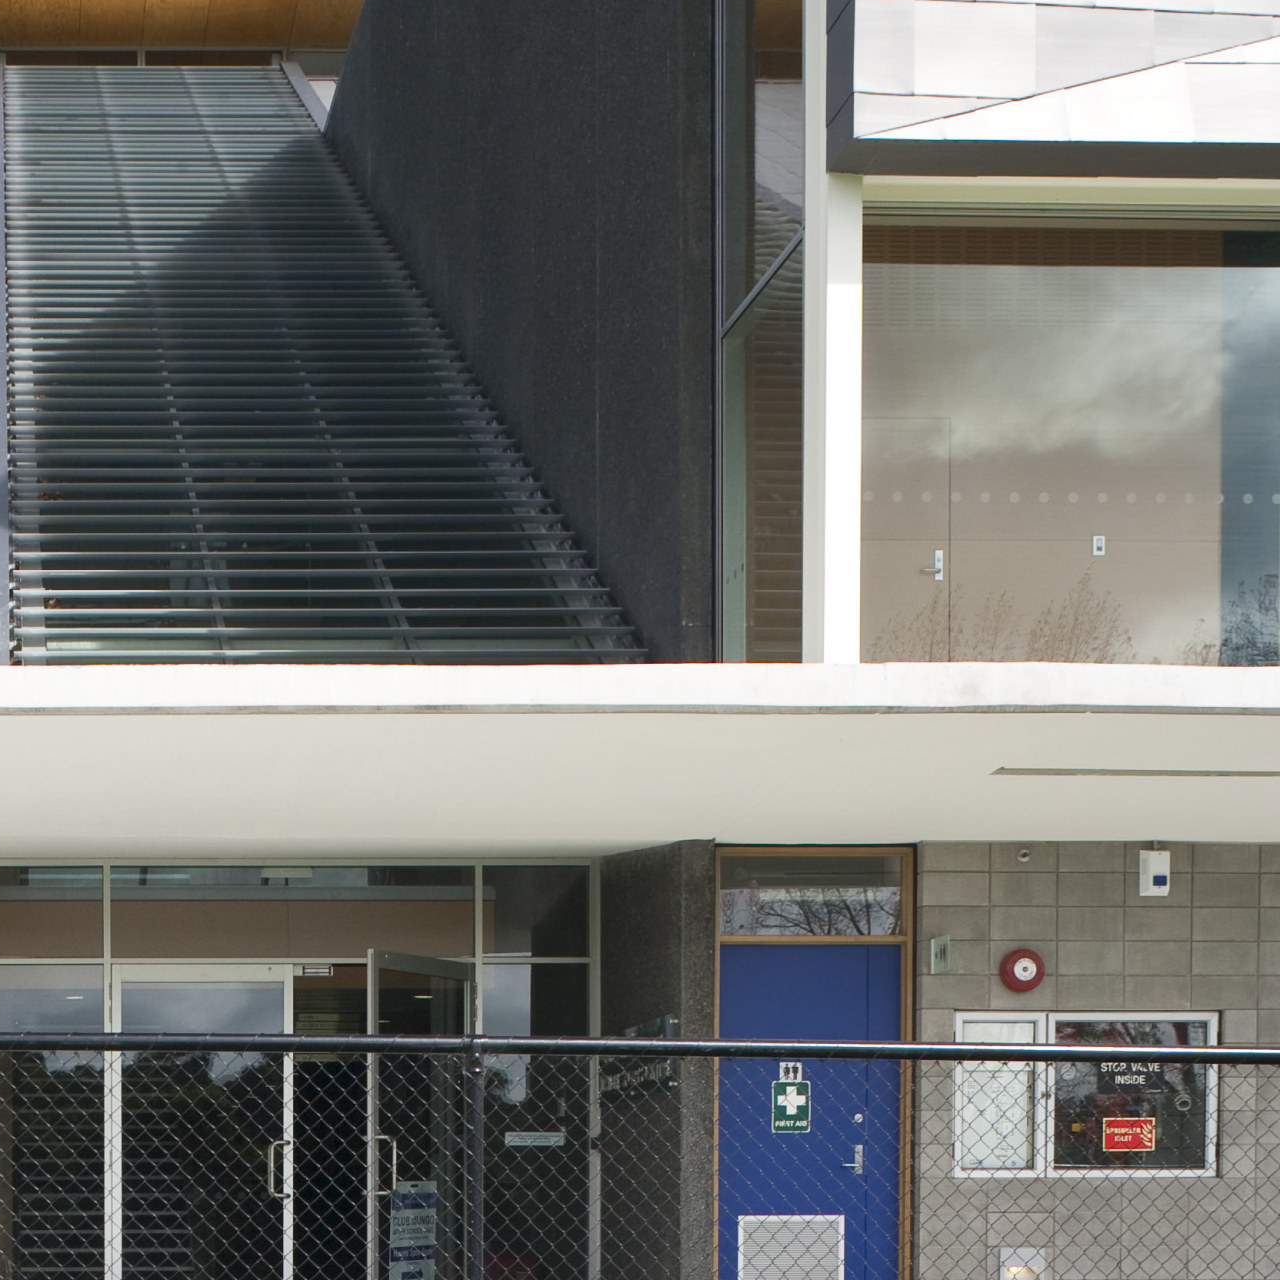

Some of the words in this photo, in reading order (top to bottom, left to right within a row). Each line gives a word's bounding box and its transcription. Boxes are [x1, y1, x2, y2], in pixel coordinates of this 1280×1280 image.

[1100, 1062, 1127, 1072] STOP
[1131, 1062, 1162, 1072] VALVE
[1114, 1075, 1147, 1085] INSIDE
[775, 1120, 794, 1128] FIRST
